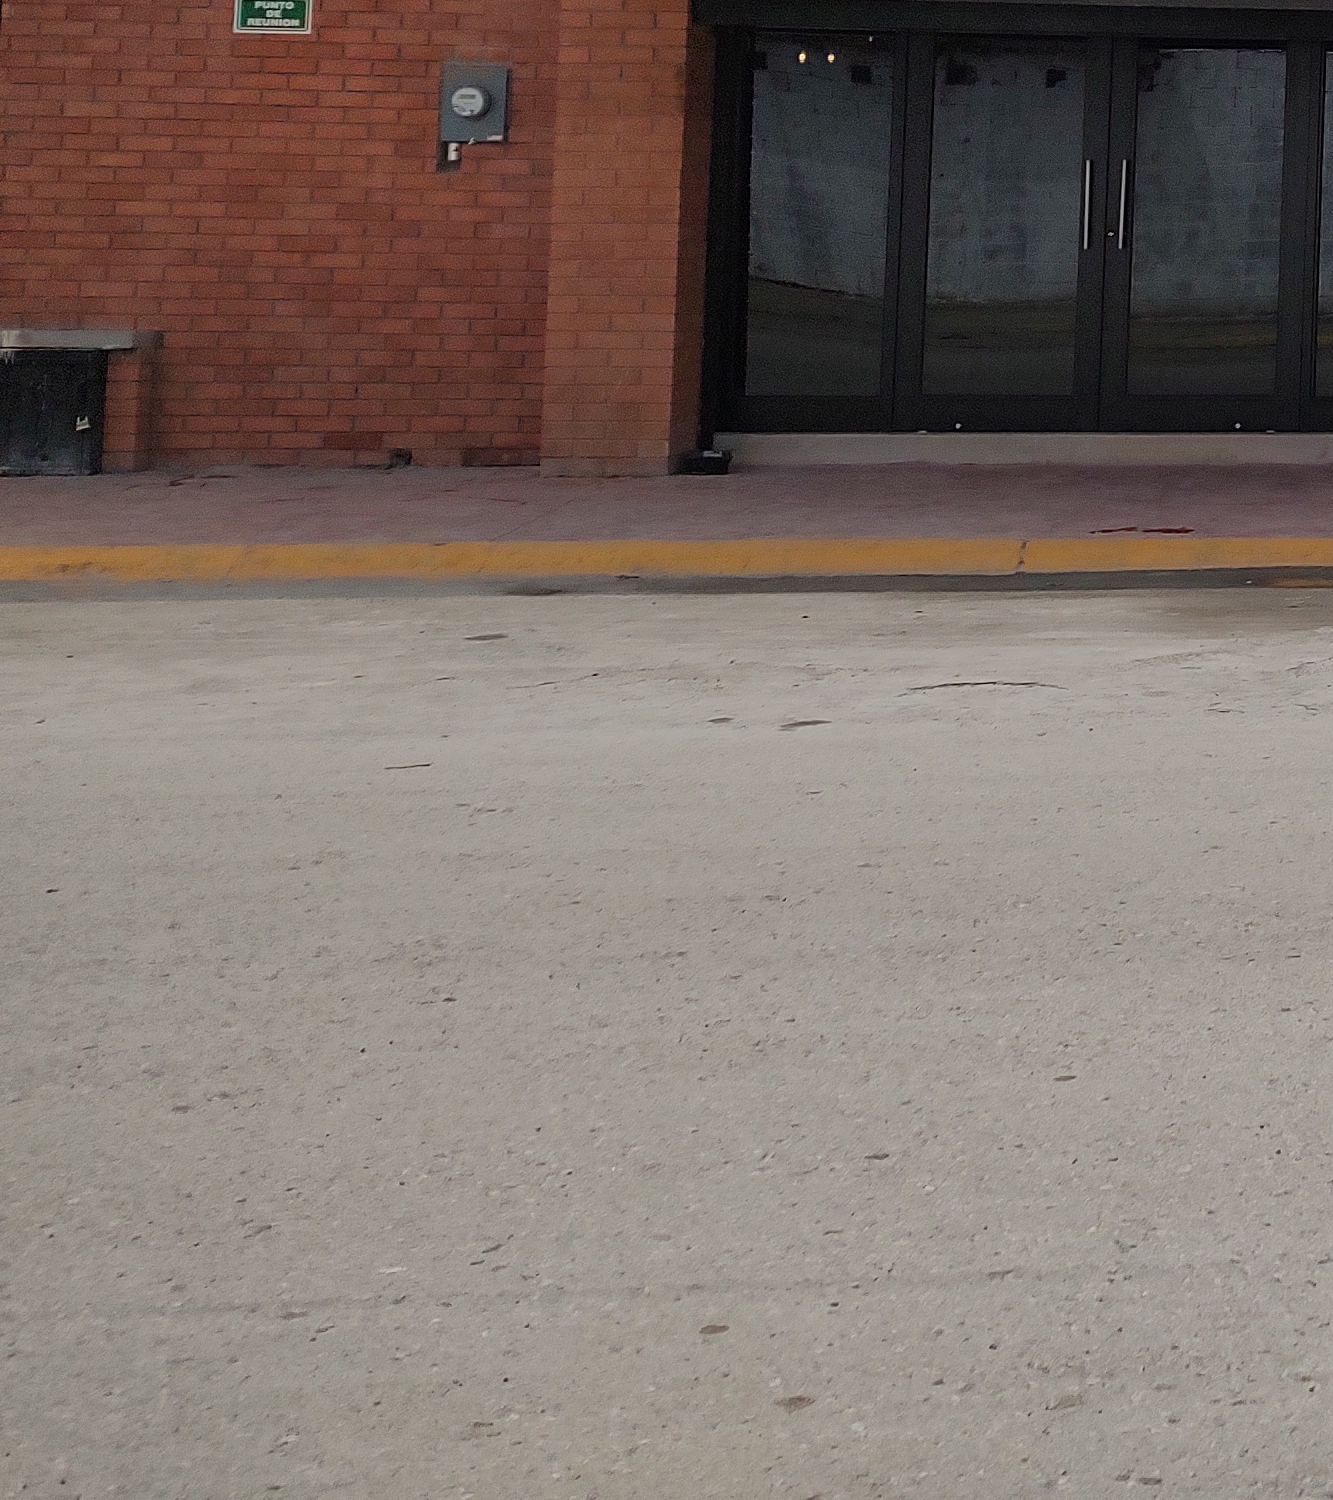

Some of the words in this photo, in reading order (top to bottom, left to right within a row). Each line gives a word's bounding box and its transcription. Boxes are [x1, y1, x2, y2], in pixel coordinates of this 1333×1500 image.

[254, 1, 295, 10] PUNTO
[265, 9, 282, 18] DE
[247, 18, 300, 27] REUNION
